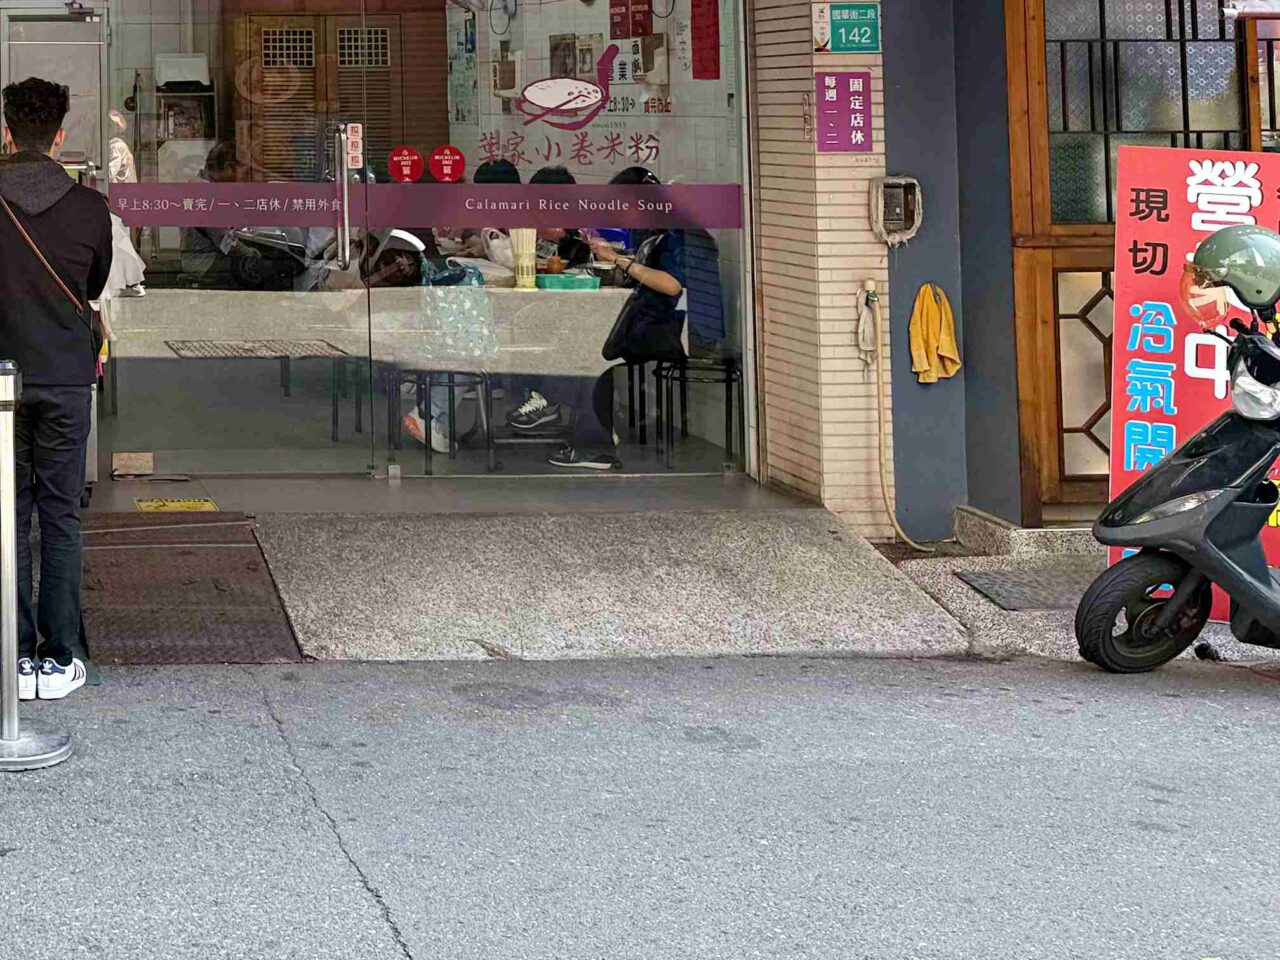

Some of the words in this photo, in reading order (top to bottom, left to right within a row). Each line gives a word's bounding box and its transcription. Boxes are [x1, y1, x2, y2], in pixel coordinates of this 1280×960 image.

[838, 26, 872, 44] 142
[824, 76, 839, 144] 每週一、二
[849, 78, 865, 145] 固定店休
[465, 198, 530, 210] Calamari
[539, 198, 569, 210] Rice
[578, 198, 629, 210] Noodle
[637, 198, 673, 213] Soup
[1128, 187, 1170, 276] 現切
[1185, 158, 1263, 400] 營中
